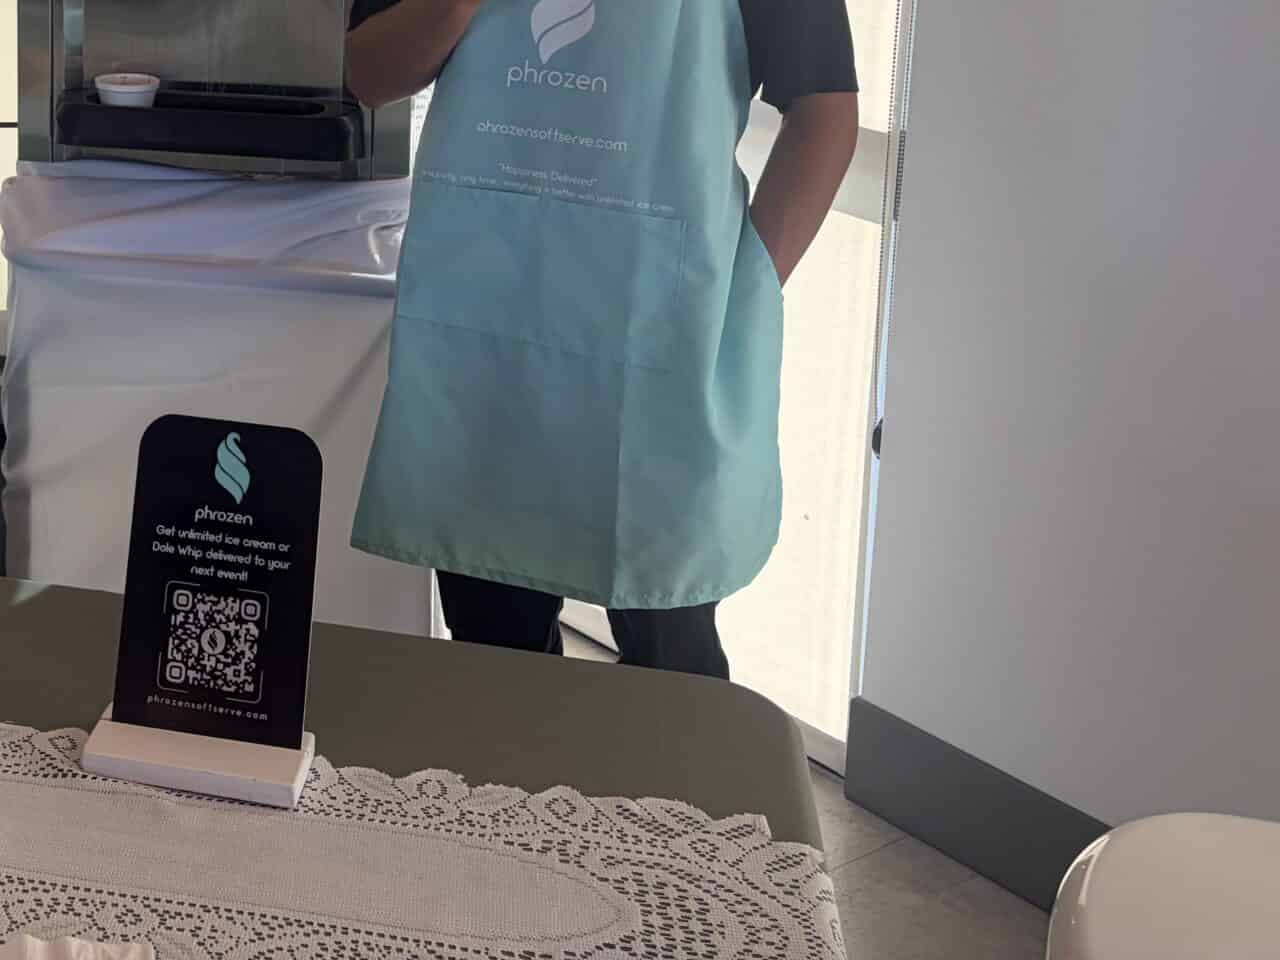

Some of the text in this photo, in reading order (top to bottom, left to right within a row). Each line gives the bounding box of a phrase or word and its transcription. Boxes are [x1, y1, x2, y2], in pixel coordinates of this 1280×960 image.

[507, 59, 608, 93] phrozen
[477, 120, 628, 152] phrozensoftserve.com
[194, 505, 253, 526] phrozen
[156, 524, 291, 552] Get unlimited ice cream or
[152, 541, 291, 571] Dole Whip delivered to your
[190, 565, 248, 582] next event!
[147, 694, 268, 720] phrozensoftserve.com
